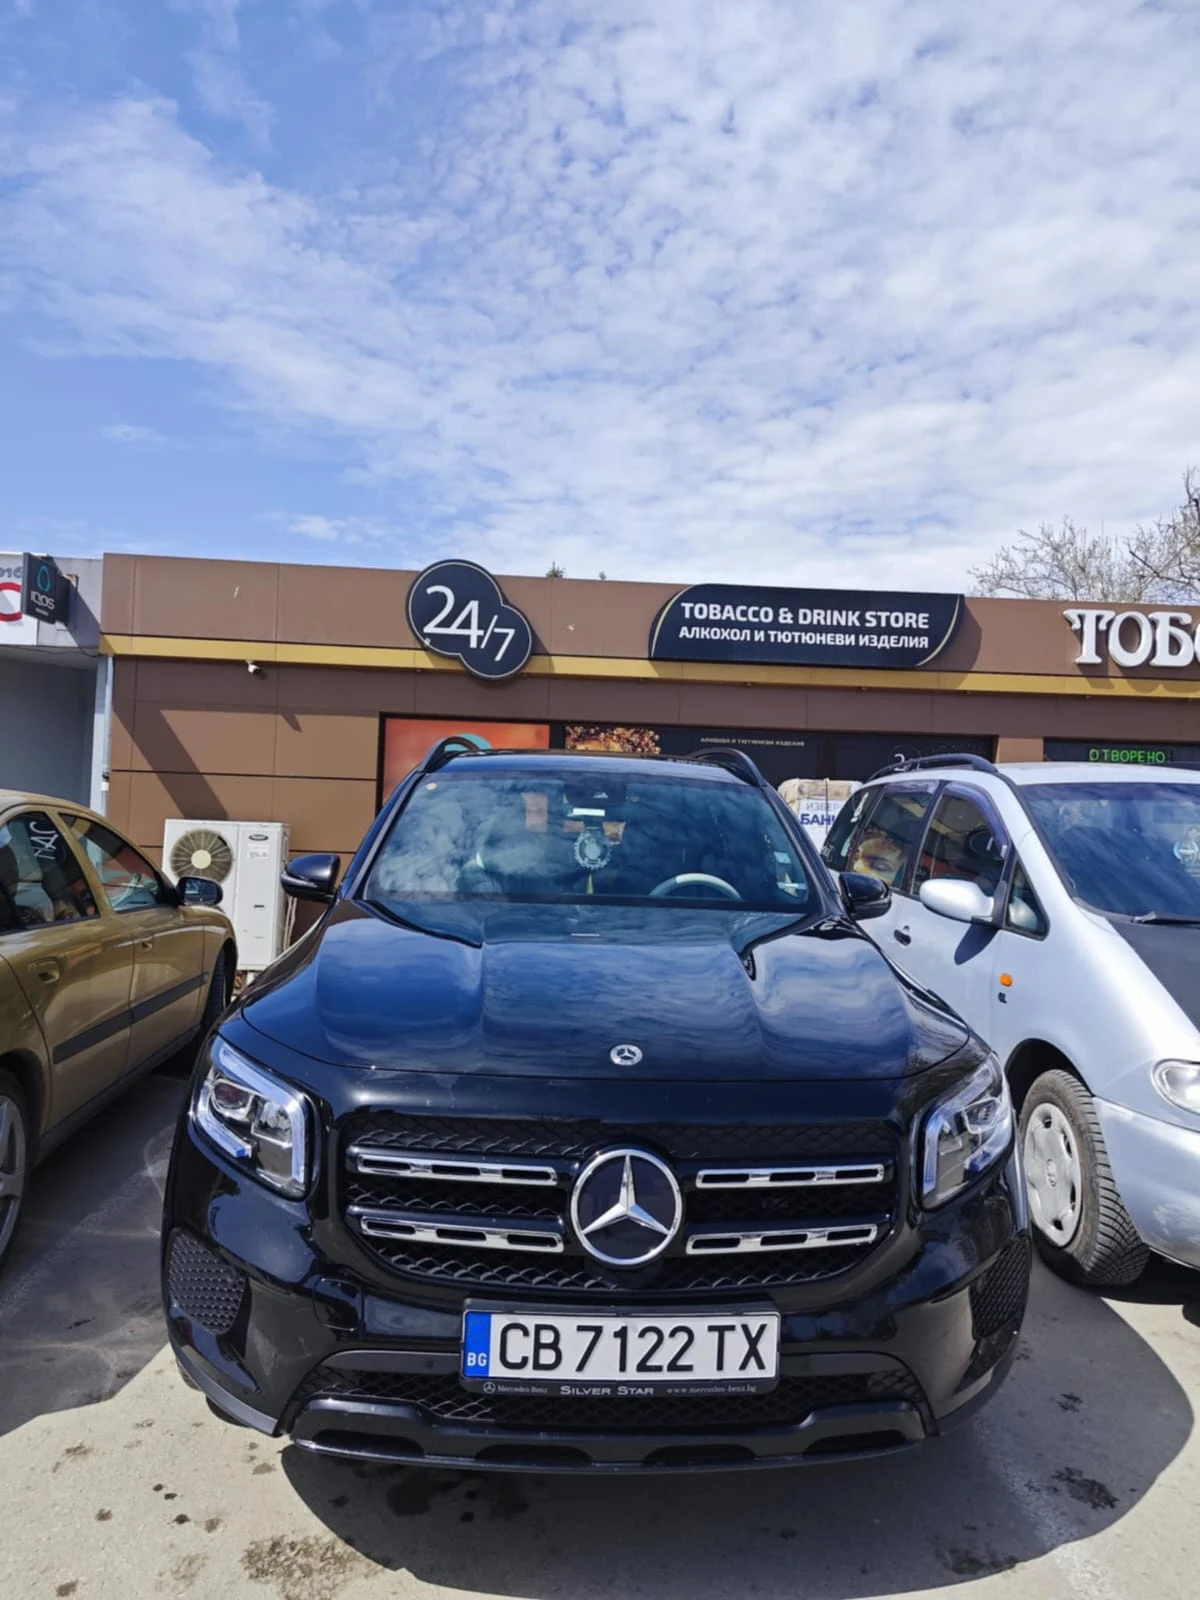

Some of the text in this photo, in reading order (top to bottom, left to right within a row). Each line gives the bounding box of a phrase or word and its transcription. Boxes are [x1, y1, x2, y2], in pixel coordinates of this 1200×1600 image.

[30, 590, 55, 610] IQOS
[423, 585, 516, 662] 24/7
[681, 602, 930, 629] TOBACCO & DRINK STORE
[679, 626, 929, 649] АЛКОХОЛ И ТЮТЮНЕВИ ИЗДЕЛИЯ
[1063, 608, 1200, 667] ТОБ
[467, 1352, 487, 1367] BG
[499, 1322, 768, 1373] CB 7122 TX
[560, 1385, 655, 1396] SILVER STAR
